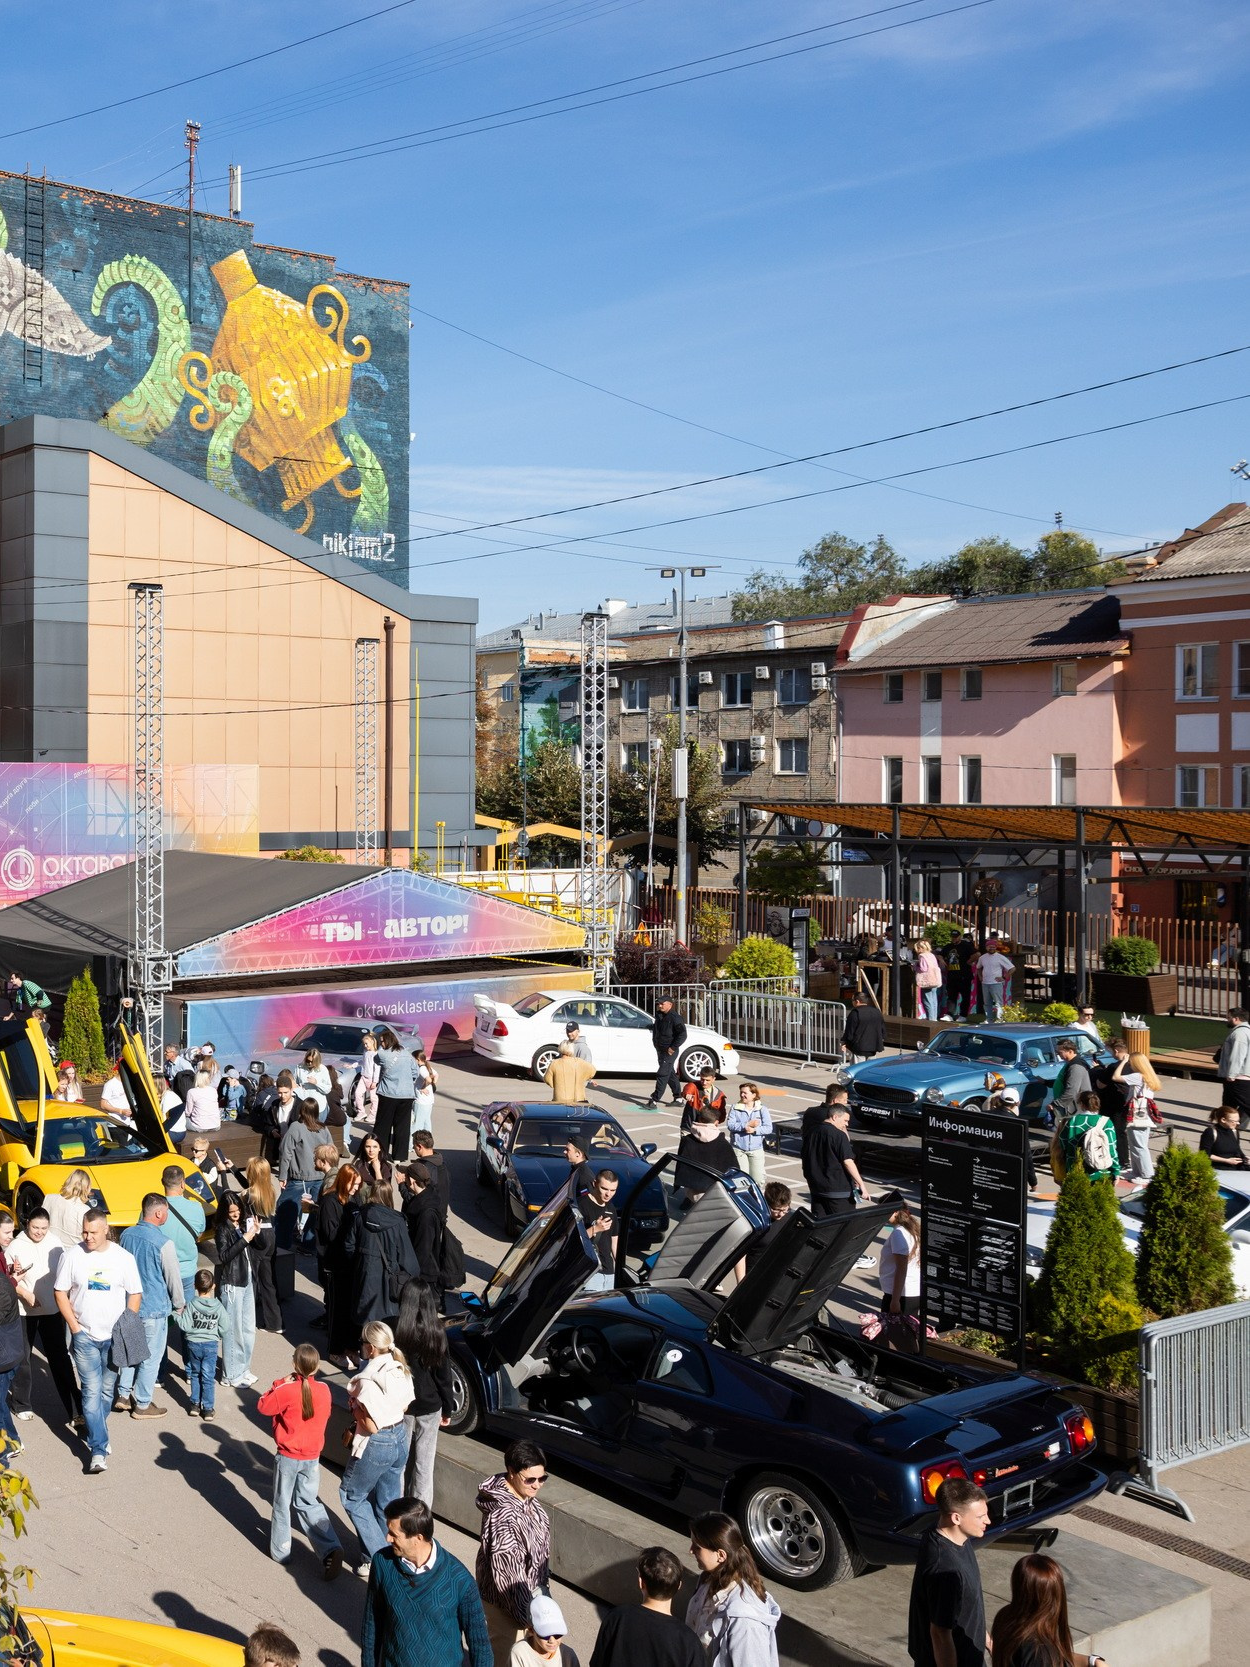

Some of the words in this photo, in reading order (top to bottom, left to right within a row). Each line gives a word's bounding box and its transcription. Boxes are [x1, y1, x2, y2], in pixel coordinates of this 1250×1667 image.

[322, 921, 363, 943] ТЫ
[383, 914, 470, 940] АВТОР!
[355, 998, 456, 1020] oktavaklaster.ru
[928, 1116, 1003, 1140] Информация
